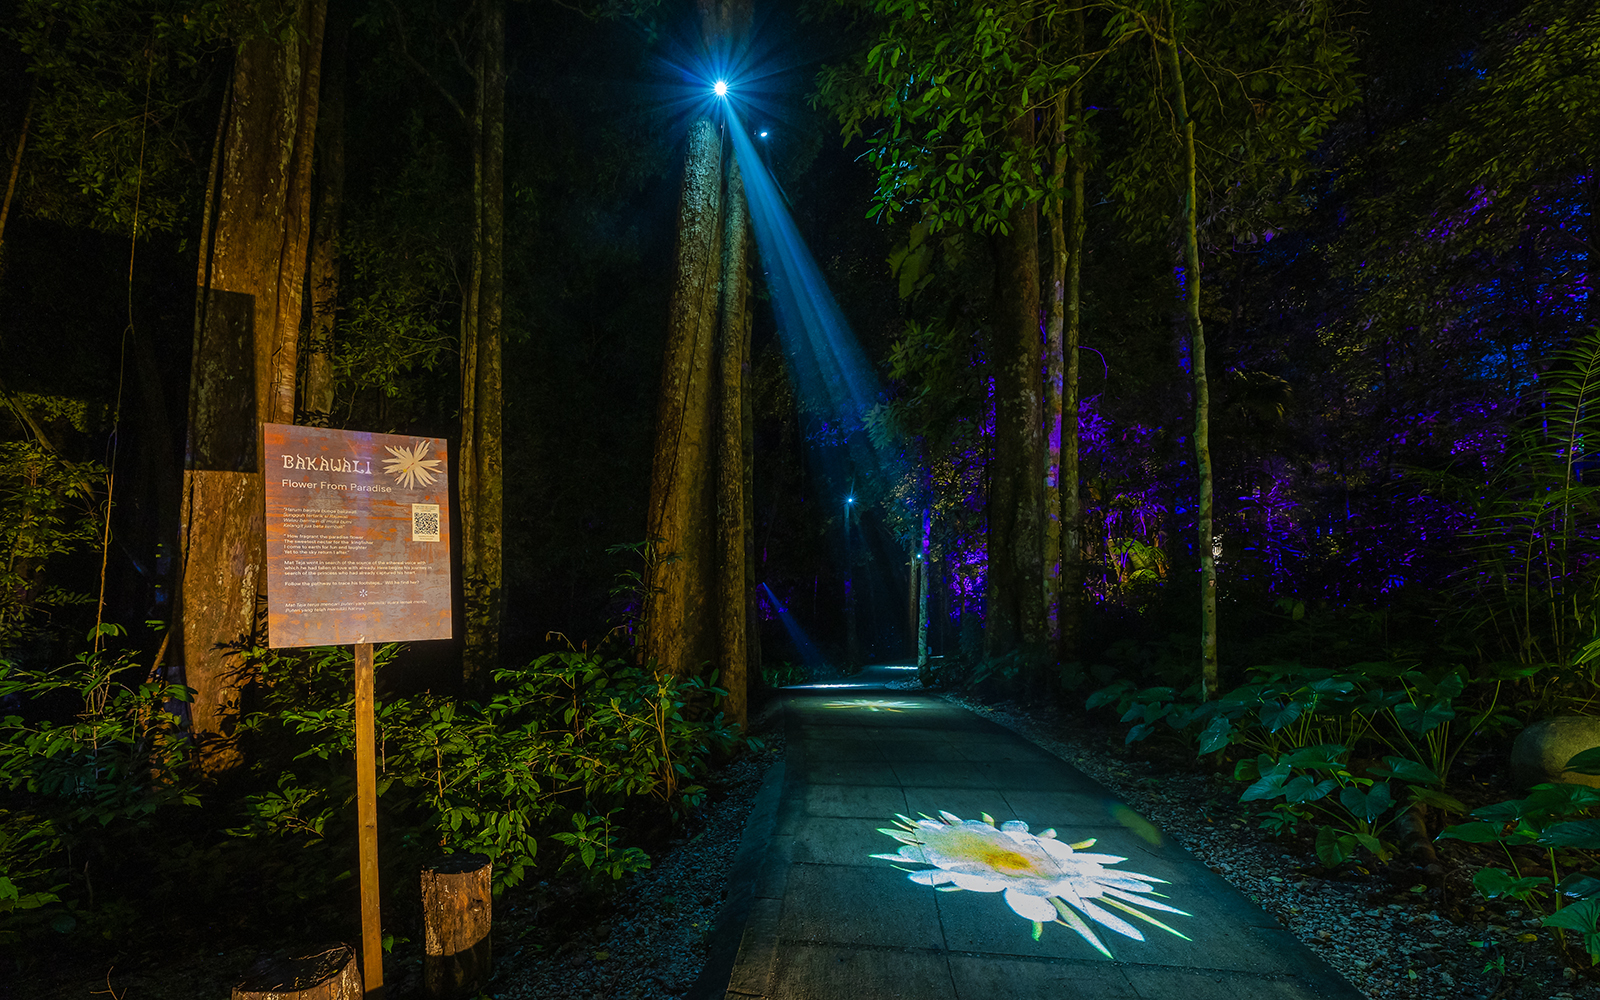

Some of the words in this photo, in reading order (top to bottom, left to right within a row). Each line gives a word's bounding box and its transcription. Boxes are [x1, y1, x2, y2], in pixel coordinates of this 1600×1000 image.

[281, 454, 372, 474] BAKAWALI
[282, 479, 317, 490] Flower
[320, 481, 347, 491] From
[350, 483, 392, 493] Paradise
